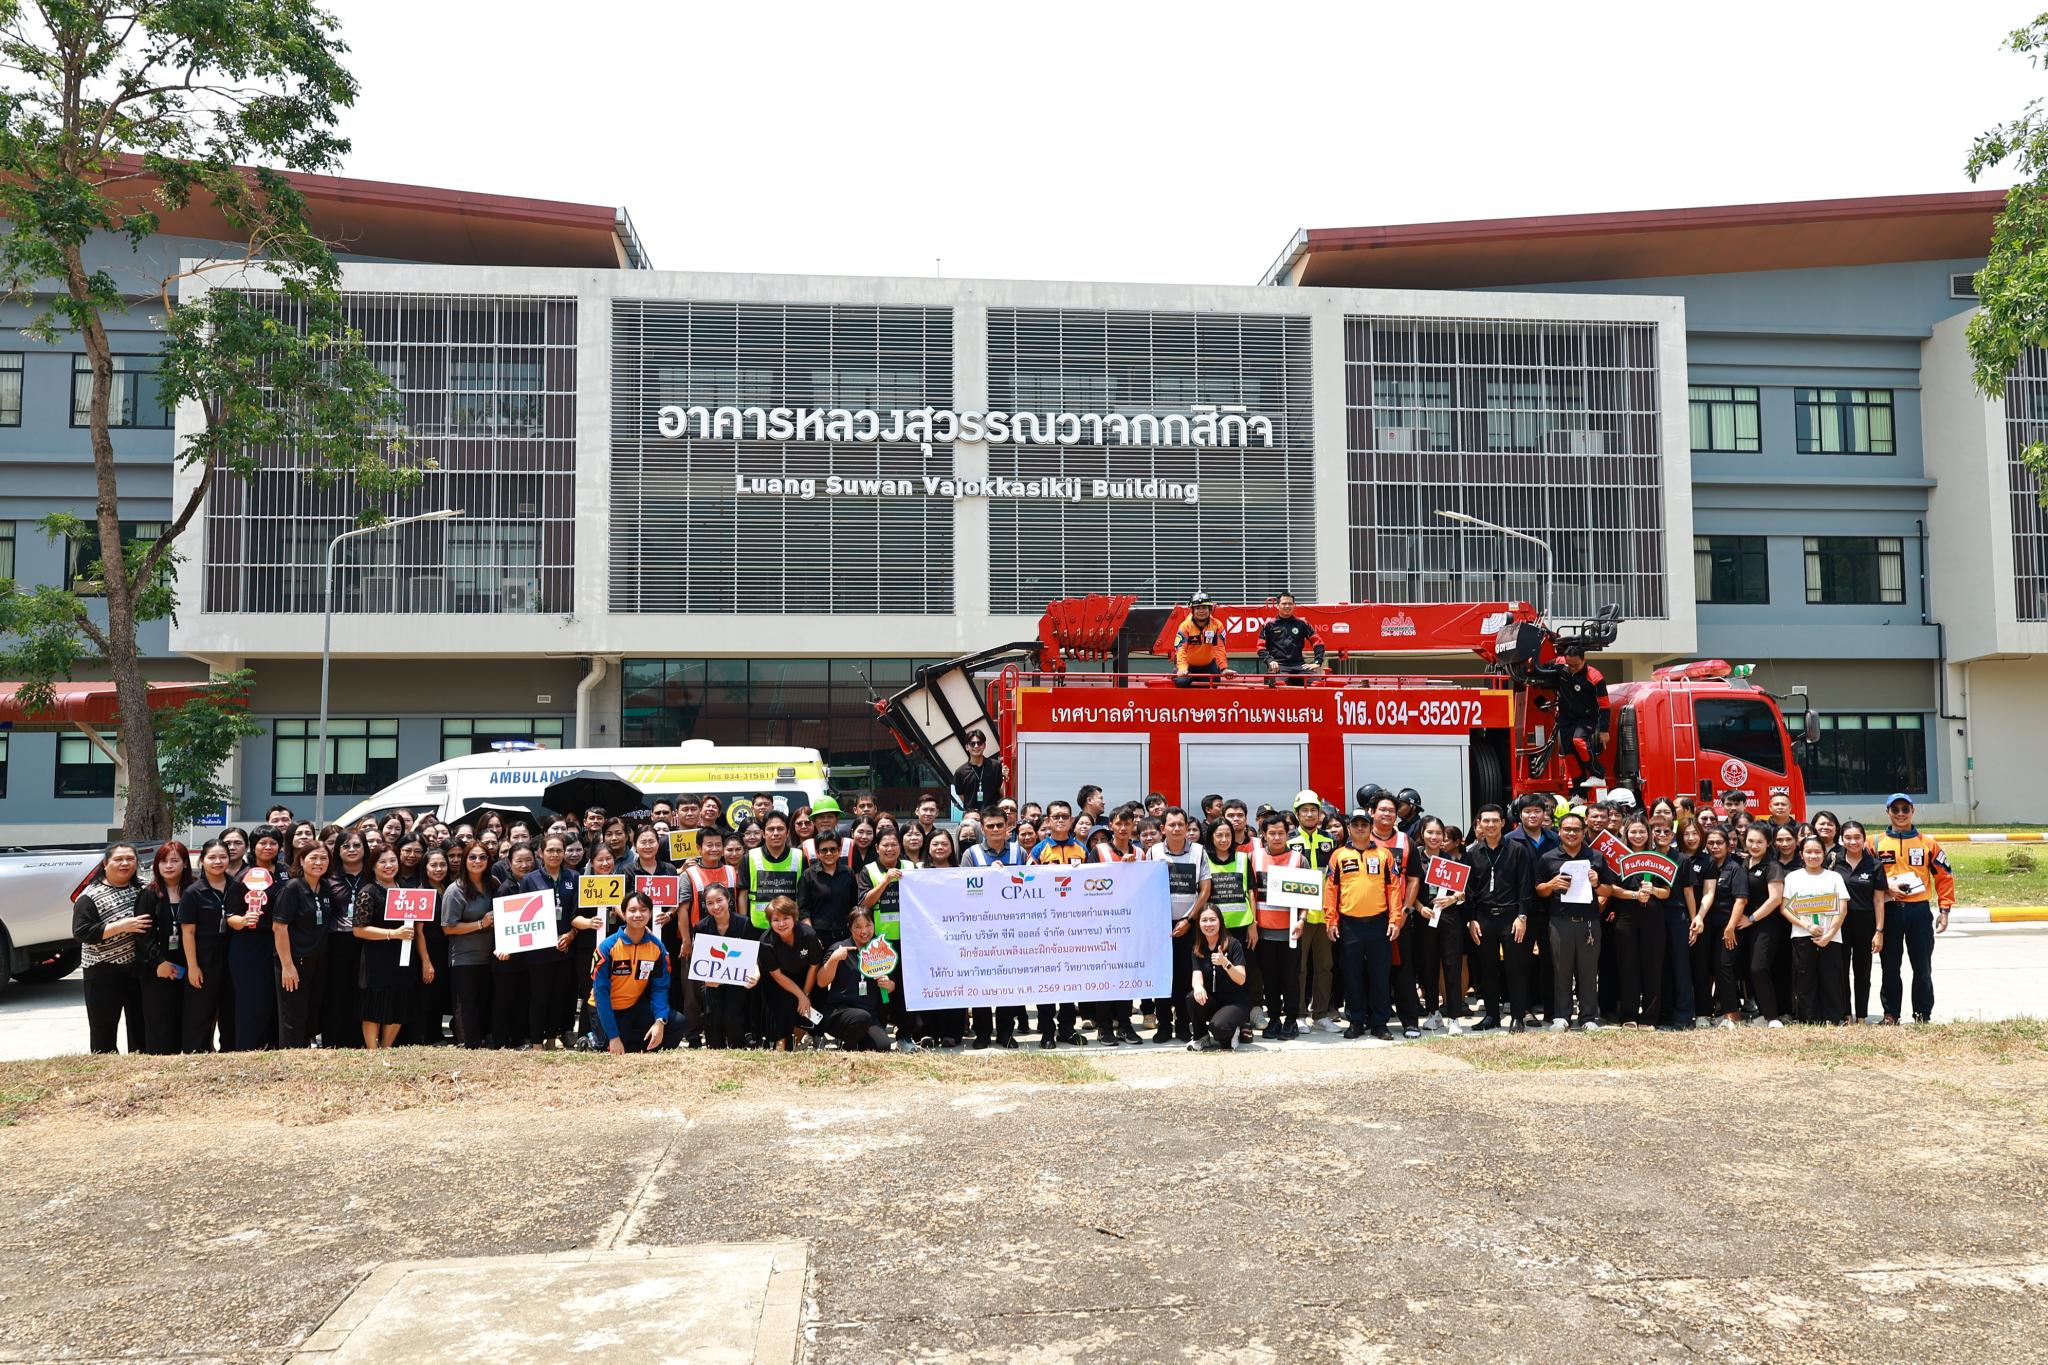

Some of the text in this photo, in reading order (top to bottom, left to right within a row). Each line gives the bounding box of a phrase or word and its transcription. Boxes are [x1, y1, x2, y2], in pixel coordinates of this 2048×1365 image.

[657, 404, 1273, 458] อาคารหลวงสุวรรณวาจกกสิกิจ
[736, 474, 1199, 504] Luang Suwan Vajokkasikij Building
[1051, 691, 1482, 726] เทศบาลตำบลเกษตรกำแพงแสน โทร. 034-352072
[673, 834, 691, 852] ชั้น
[1600, 838, 1616, 858] ชั้น
[1435, 860, 1461, 883] ชั้น 1
[584, 879, 619, 898] ชั้น 2
[642, 877, 670, 897] ชั้น 1
[967, 877, 984, 888] KU
[394, 890, 427, 911] ชั้น 3
[503, 894, 543, 947] 7
[942, 907, 1132, 923] มหาวิทยาลัยเกษตรศาสตร์ วิทยาเขตกำแพงแสน
[944, 924, 1131, 941] ร่วมกับ บริษัท ซีพี ออลล์ จำกัด (มหาชน) ทำการ
[960, 941, 1117, 958] ฝึกซ้อมดับเพลิงและฝึกซ้อมอพยพหนีไฟ
[930, 960, 1145, 978] ให้กับ มหาวิทยาลัยเกษตรศาสตร์ วิทยาเขตกำแพงแสน
[922, 984, 964, 998] วันจันทร์ที่
[967, 987, 979, 997] 20
[982, 986, 1014, 996] เมษายน
[1017, 985, 1035, 994] พ.ศ.
[1038, 983, 1060, 993] 2569
[1063, 983, 1082, 992] เวลา
[1085, 981, 1110, 991] 09.00
[1118, 979, 1143, 989] 22.00
[1145, 980, 1154, 988] น.
